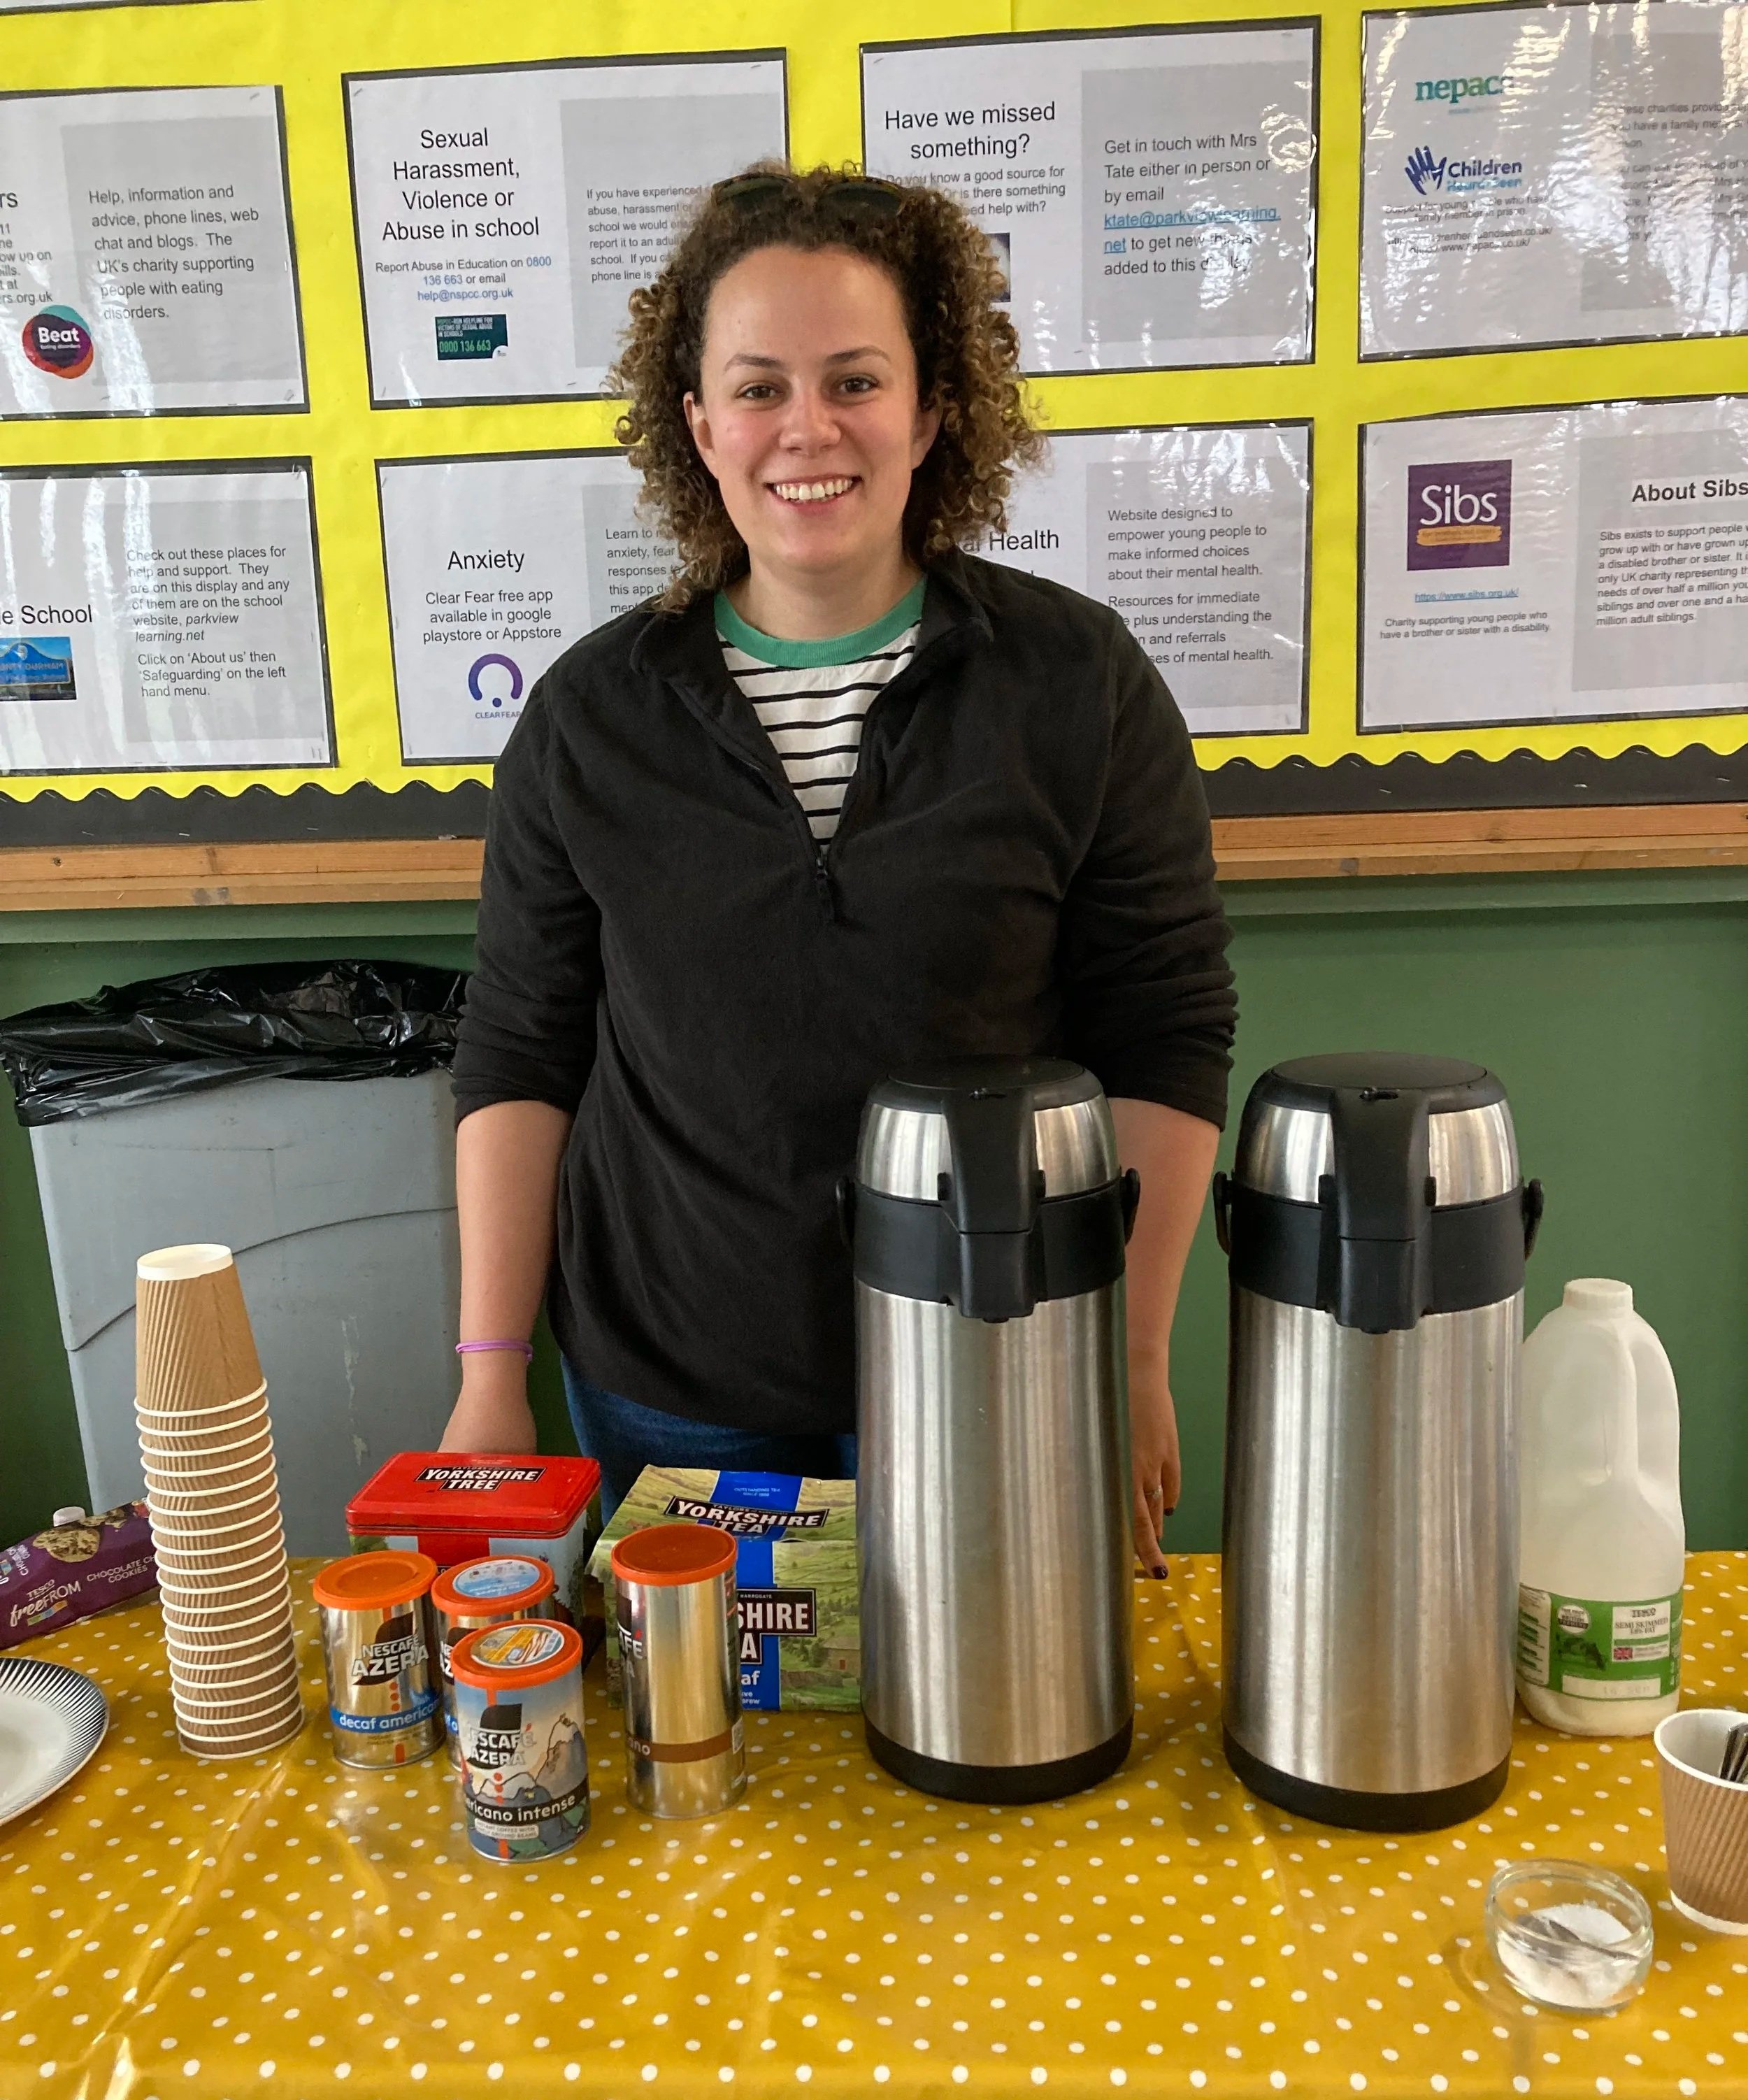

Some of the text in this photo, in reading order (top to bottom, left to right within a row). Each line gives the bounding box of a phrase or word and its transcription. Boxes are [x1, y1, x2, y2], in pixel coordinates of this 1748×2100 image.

[886, 101, 1054, 129] Have we missed
[421, 127, 487, 148] Sexual
[911, 134, 1029, 159] something?
[1105, 134, 1256, 153] Get in touch with Mrs
[394, 158, 519, 180] Harassment,
[930, 166, 1065, 183] know a good source for
[1104, 159, 1270, 178] Tate either in person or
[1448, 159, 1521, 178] Children
[89, 185, 234, 206] Help, information and
[402, 190, 514, 209] Violence or
[587, 190, 592, 199] If
[596, 191, 613, 201] you
[617, 189, 639, 197] have
[1105, 187, 1163, 206] by email
[92, 208, 259, 228] advice, phone lines, web
[588, 203, 679, 215] abuse, harassment
[383, 217, 538, 241] Abuse in school
[95, 233, 232, 250] chat and blogs. The
[97, 256, 254, 274] UK's charity supporting
[375, 262, 409, 273] Report
[411, 262, 443, 271] Abuse
[446, 259, 454, 270] in
[458, 259, 507, 269] Education
[526, 256, 551, 266] 0800
[424, 275, 441, 285] 136
[444, 275, 463, 285] 663
[479, 273, 506, 283] email
[101, 281, 222, 299] people with eating
[417, 287, 513, 302] help@nspcc.org.uk
[104, 305, 169, 319] disorders.
[38, 327, 79, 343] Beat
[440, 340, 491, 352] 0800 136 663
[1632, 479, 1748, 502] About Sibs
[1108, 506, 1232, 521] Website designed to
[1420, 485, 1497, 524] Sibs
[989, 529, 1059, 551] Health
[1108, 525, 1266, 543] empower young people to
[1600, 531, 1621, 541] Sibs
[1624, 530, 1652, 539] exists
[1668, 527, 1705, 538] support
[1709, 524, 1742, 536] people
[127, 546, 286, 561] Check out these places for
[448, 550, 524, 572] Anxiety
[1108, 564, 1262, 580] about their mental health.
[1596, 568, 1738, 585] only UK charity representing
[426, 590, 552, 604] Clear Fear free app
[22, 604, 92, 624] School
[134, 613, 238, 627] website, parkview
[431, 608, 551, 623] available in google
[1385, 618, 1416, 627] Charity
[1419, 616, 1464, 627] supporting
[1468, 615, 1494, 624] young
[1497, 613, 1526, 622] people
[1596, 616, 1627, 625] million
[1631, 615, 1654, 623] adult
[136, 630, 204, 643] learning.net
[424, 627, 561, 645] playstore or Appstore
[138, 654, 166, 665] Click
[250, 651, 275, 662] then
[424, 1469, 538, 1480] YORKSHIRE
[449, 1480, 498, 1490] TREE
[676, 1501, 819, 1527] YORKSHIRE
[717, 1521, 764, 1534] TEA
[87, 1559, 141, 1582] CHOCOLATE
[108, 1565, 148, 1583] COOKIES
[27, 1579, 55, 1599] TESCO
[10, 1580, 81, 1627] freeFROM
[1632, 1608, 1656, 1617] TESCO
[352, 1645, 429, 1677] AZERA
[339, 1715, 376, 1729] decaf
[518, 1795, 575, 1822] intense
